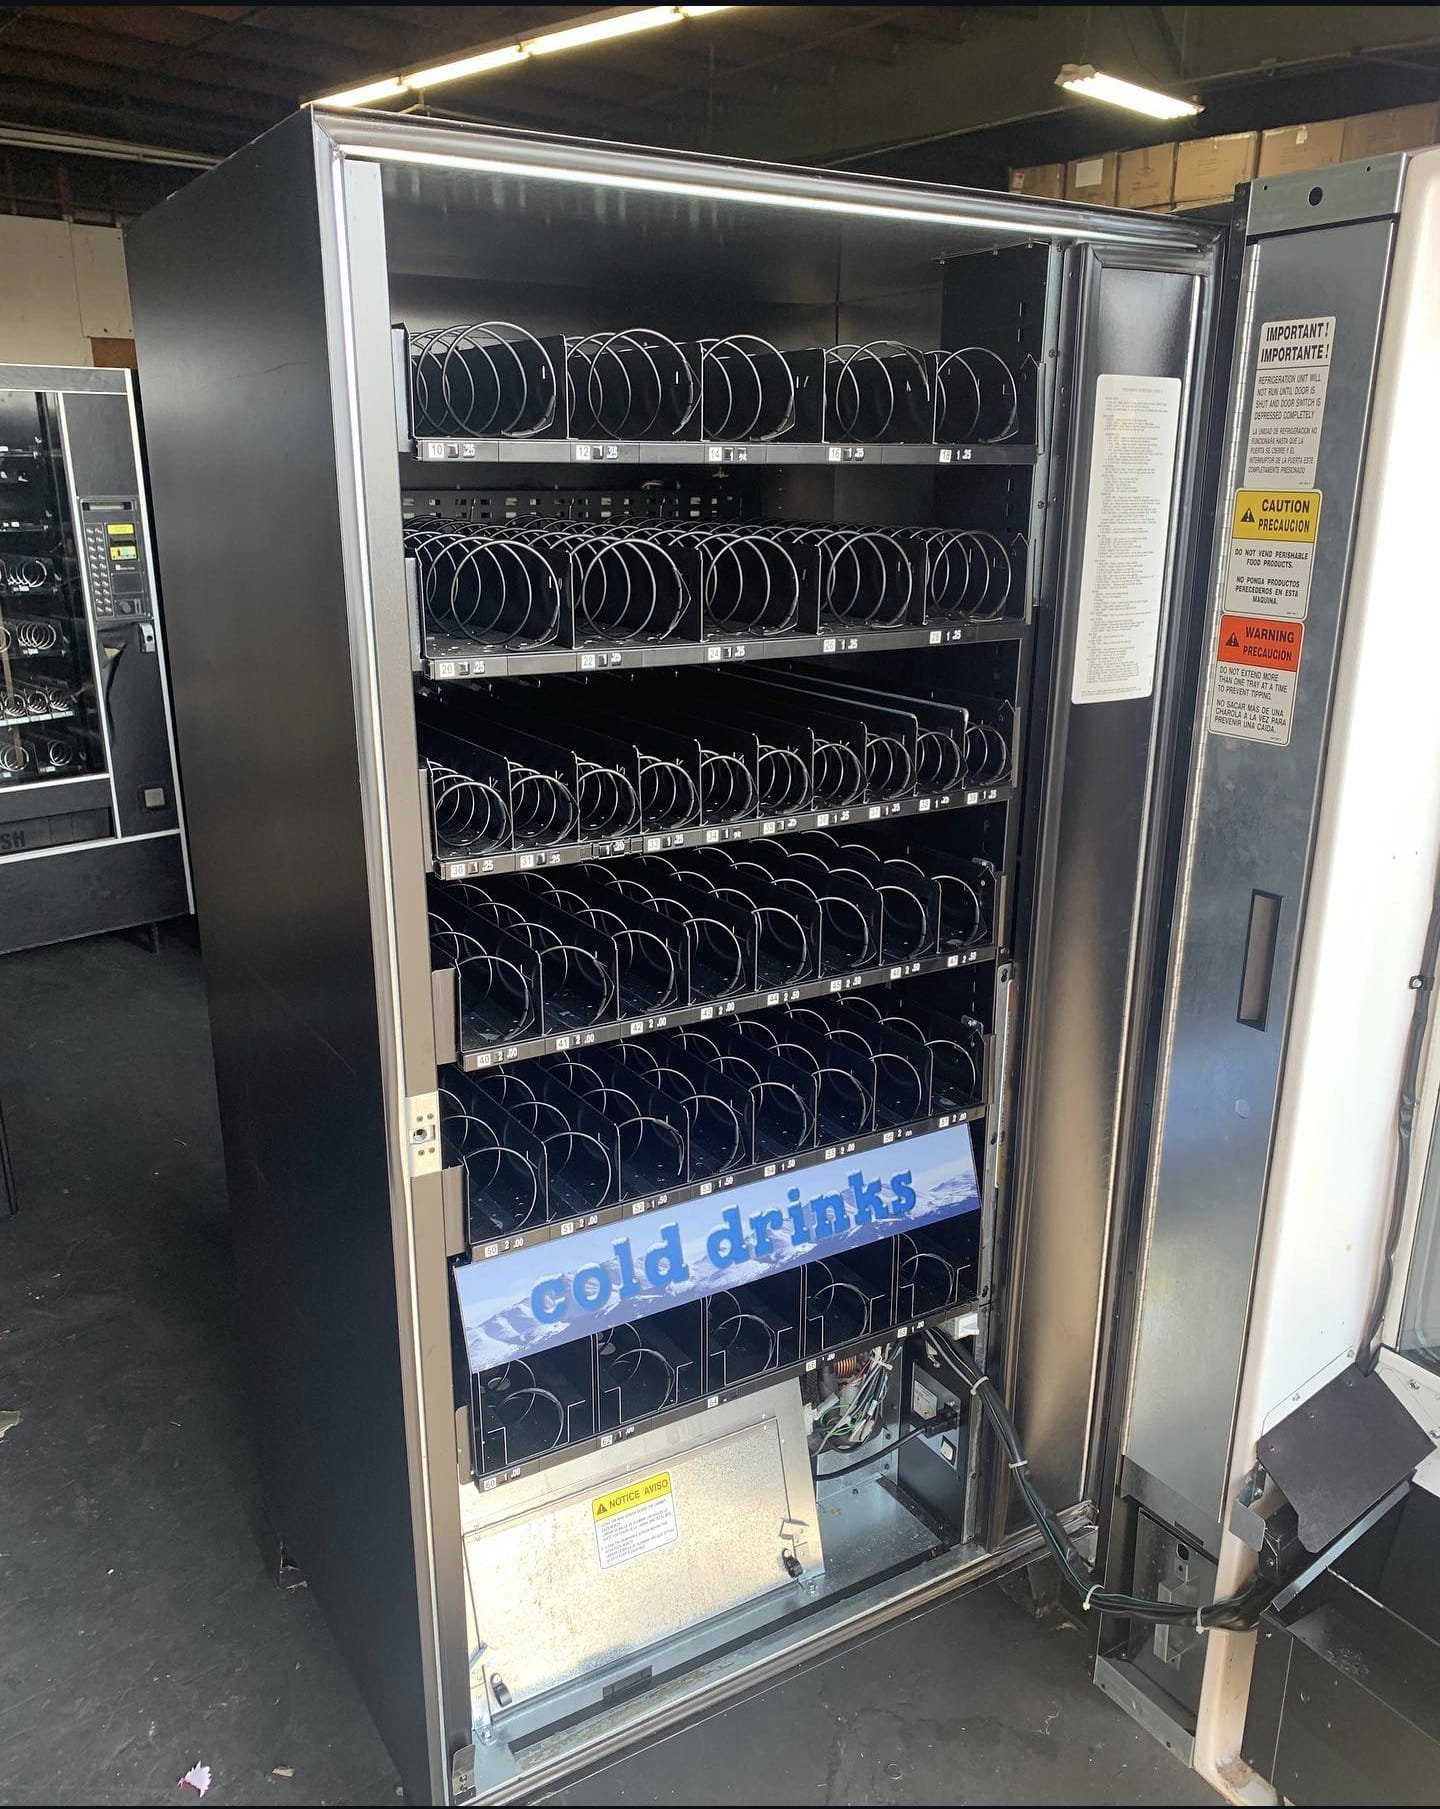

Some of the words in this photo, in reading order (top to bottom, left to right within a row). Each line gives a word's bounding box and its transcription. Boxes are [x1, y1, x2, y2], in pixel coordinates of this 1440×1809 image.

[1258, 375, 1296, 384] REFRIGERATION
[1297, 374, 1308, 383] UNIT
[1257, 388, 1267, 396] NOT
[1295, 386, 1309, 395] DOOR
[1310, 386, 1315, 394] IS
[1256, 400, 1268, 408] SHUT
[1269, 399, 1279, 408] AND
[1281, 399, 1294, 407] DOOR
[1316, 398, 1321, 406] IS
[1255, 411, 1282, 420] DEPRESSED
[1283, 411, 1314, 419] COMPLETELY
[1262, 499, 1310, 513] CAUTION
[1258, 518, 1310, 533] PRECAUCION
[1259, 550, 1272, 558] VEND
[1275, 551, 1309, 560] PERISHABLE
[1247, 577, 1264, 585] PONGA
[1267, 578, 1300, 588] PRODUCTOS
[1235, 585, 1272, 595] PERECEDEROS
[1285, 589, 1298, 597] ESTA
[1245, 626, 1294, 643] WARNING
[1242, 645, 1292, 662] PRECAUCION
[1219, 666, 1228, 674] DO
[1228, 667, 1239, 675] NOT
[1241, 669, 1262, 679] EXTEND
[1263, 672, 1279, 681] MORE
[1219, 675, 1232, 684] THAN
[1234, 677, 1245, 686] ONE
[1247, 679, 1260, 688] TRAY
[1261, 681, 1268, 690] AT
[1275, 683, 1288, 693] TIME
[1226, 686, 1250, 696] PREVENT
[1216, 699, 1225, 707] NO
[1227, 700, 1245, 710] SACAR
[1247, 703, 1259, 713] MAS
[1261, 706, 1270, 715] DE
[1271, 708, 1284, 717] UNA
[1214, 716, 1241, 727] PREVENIR
[1243, 720, 1255, 729] UNA
[1215, 707, 1241, 718] CHAROLA
[1243, 712, 1247, 720] A
[1249, 713, 1256, 721] LA
[1259, 714, 1269, 723] VEZ
[1271, 717, 1287, 726] PARA
[531, 1221, 691, 1325] cold
[706, 1167, 917, 1269] drinks
[609, 1490, 640, 1509] NOTICE
[644, 1479, 669, 1496] AVISO
